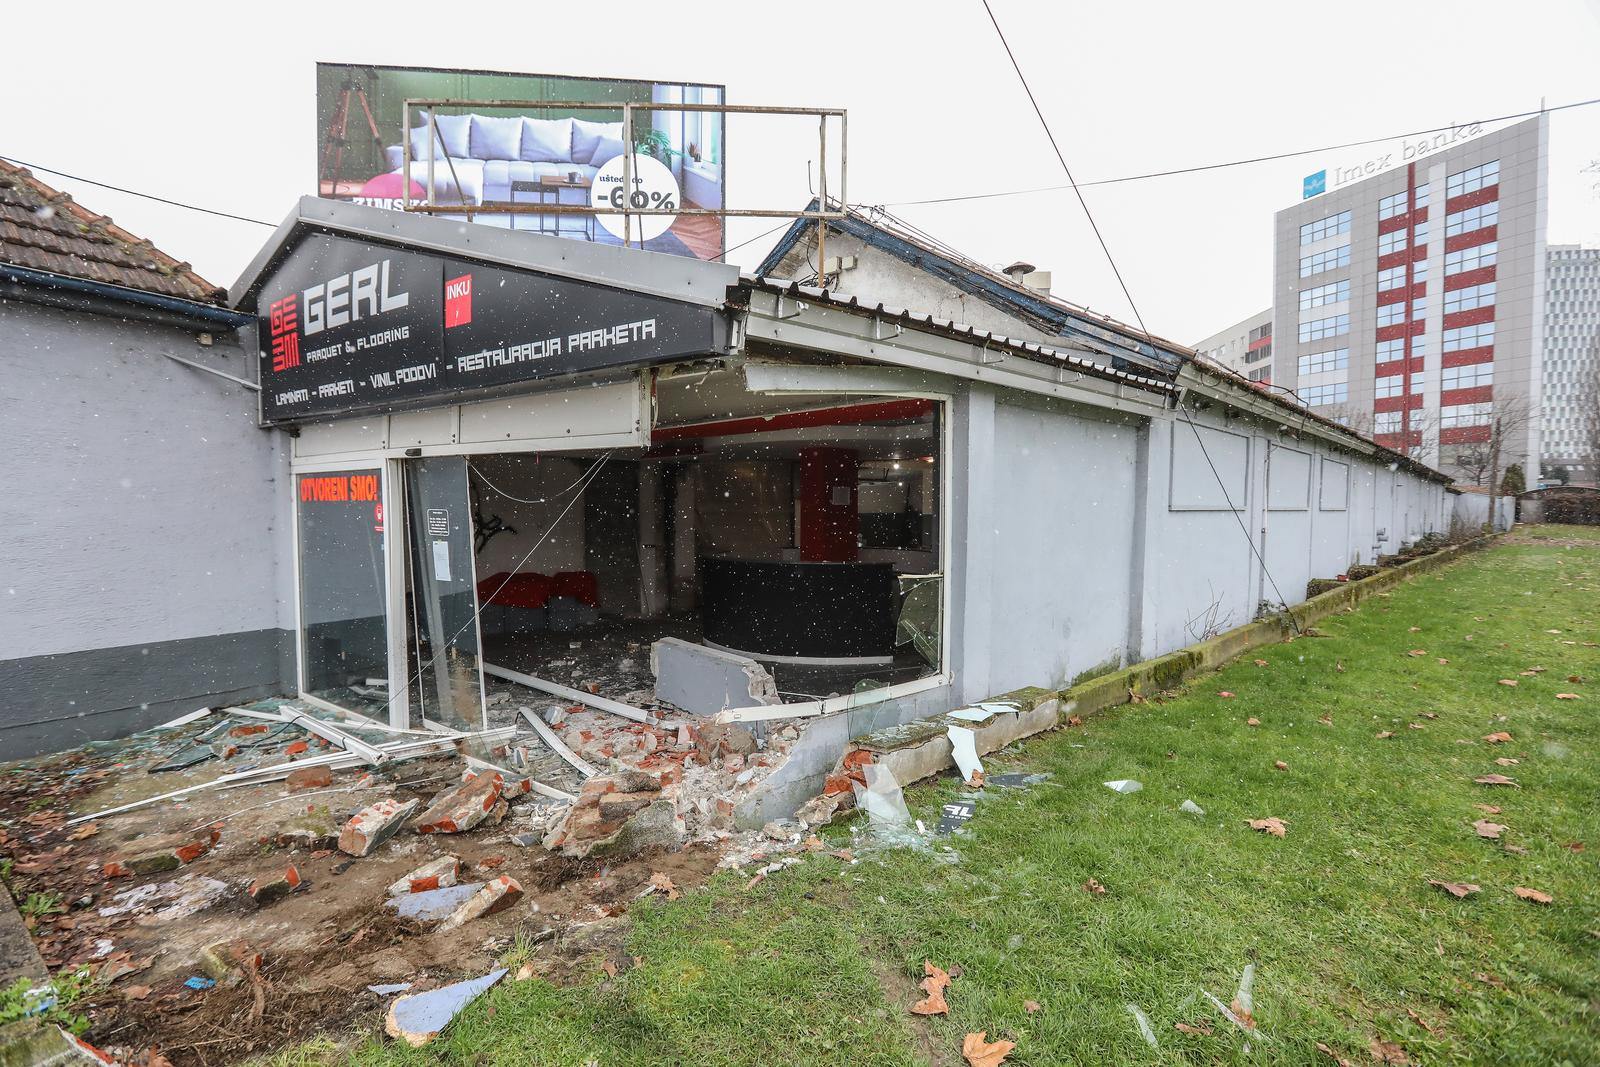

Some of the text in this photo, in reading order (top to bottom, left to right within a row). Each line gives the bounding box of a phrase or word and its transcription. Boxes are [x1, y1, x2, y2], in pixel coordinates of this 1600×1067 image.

[1334, 120, 1484, 186] Imex banka
[597, 186, 675, 209] -60%
[303, 259, 409, 336] GERL
[447, 279, 470, 300] INKU
[275, 389, 309, 405] LAMINATI
[319, 380, 355, 398] PARKETI
[370, 371, 396, 389] VINIL
[396, 363, 437, 384] PODOVI
[458, 337, 561, 373] RESTAURACIJA
[568, 318, 656, 353] PARKETA
[306, 326, 410, 363] PARQUET & FLOORING
[301, 475, 378, 502] OTVORENI SMO!
